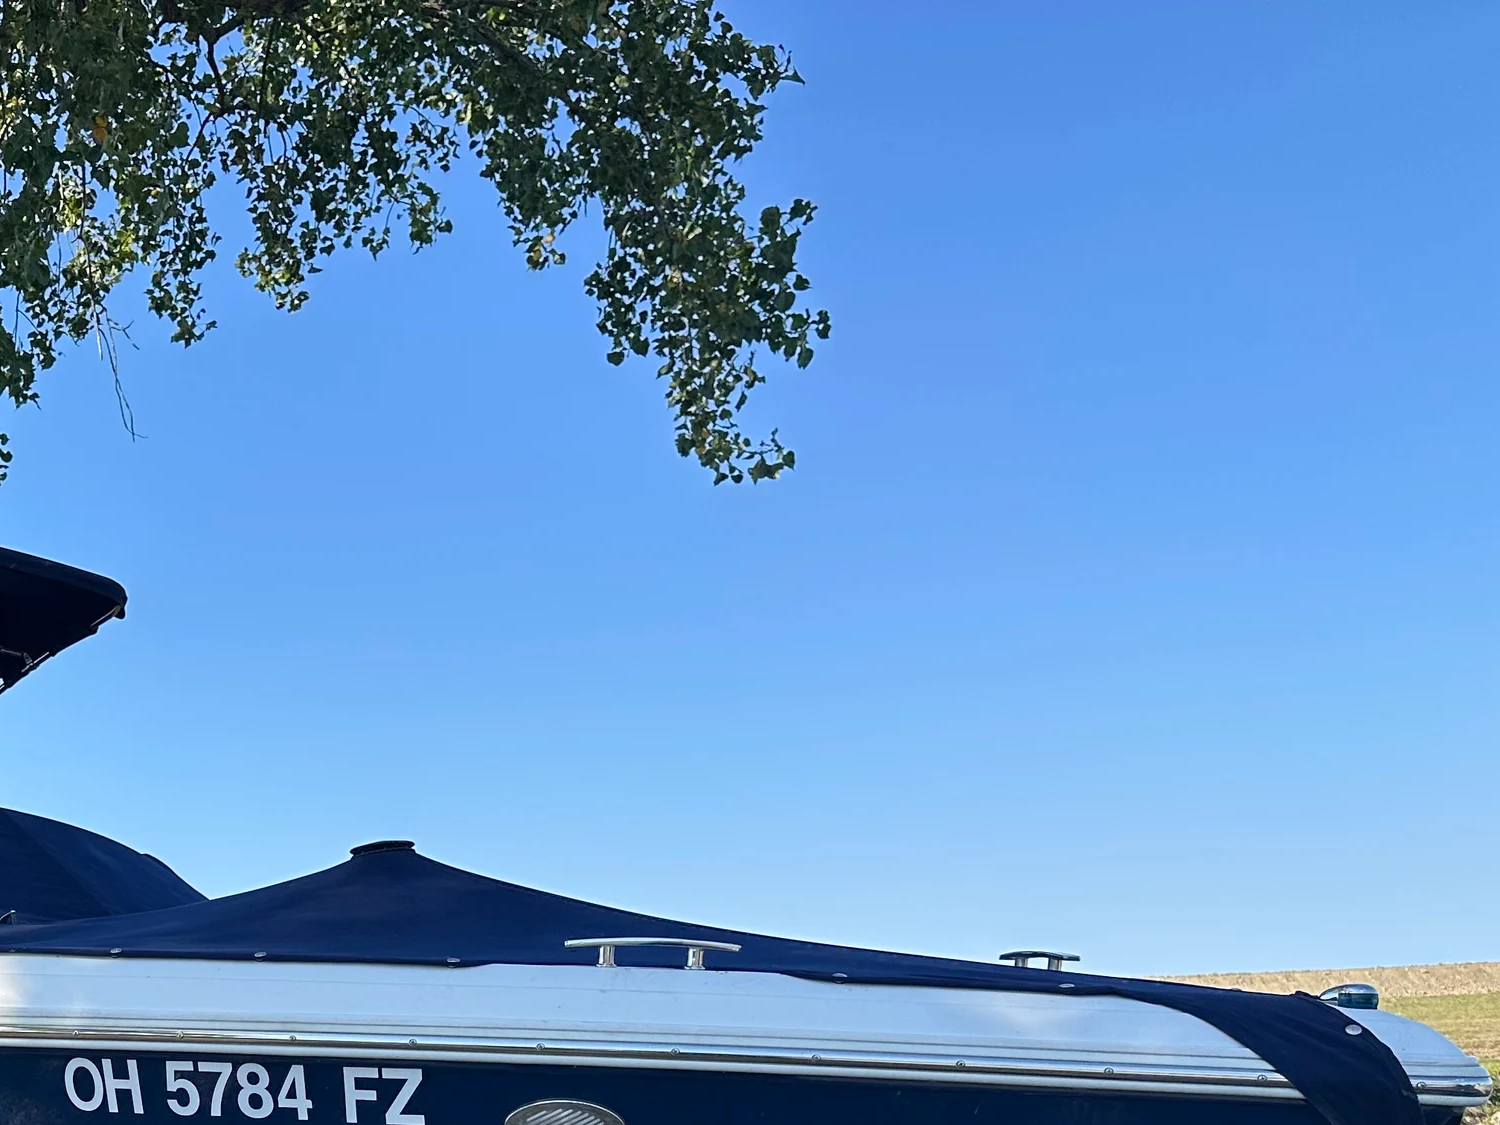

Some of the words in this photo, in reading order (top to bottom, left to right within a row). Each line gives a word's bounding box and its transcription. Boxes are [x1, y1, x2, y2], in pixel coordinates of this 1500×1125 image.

[64, 1057, 145, 1115] OH
[166, 1060, 313, 1120] 5784
[343, 1066, 426, 1125] FZ
